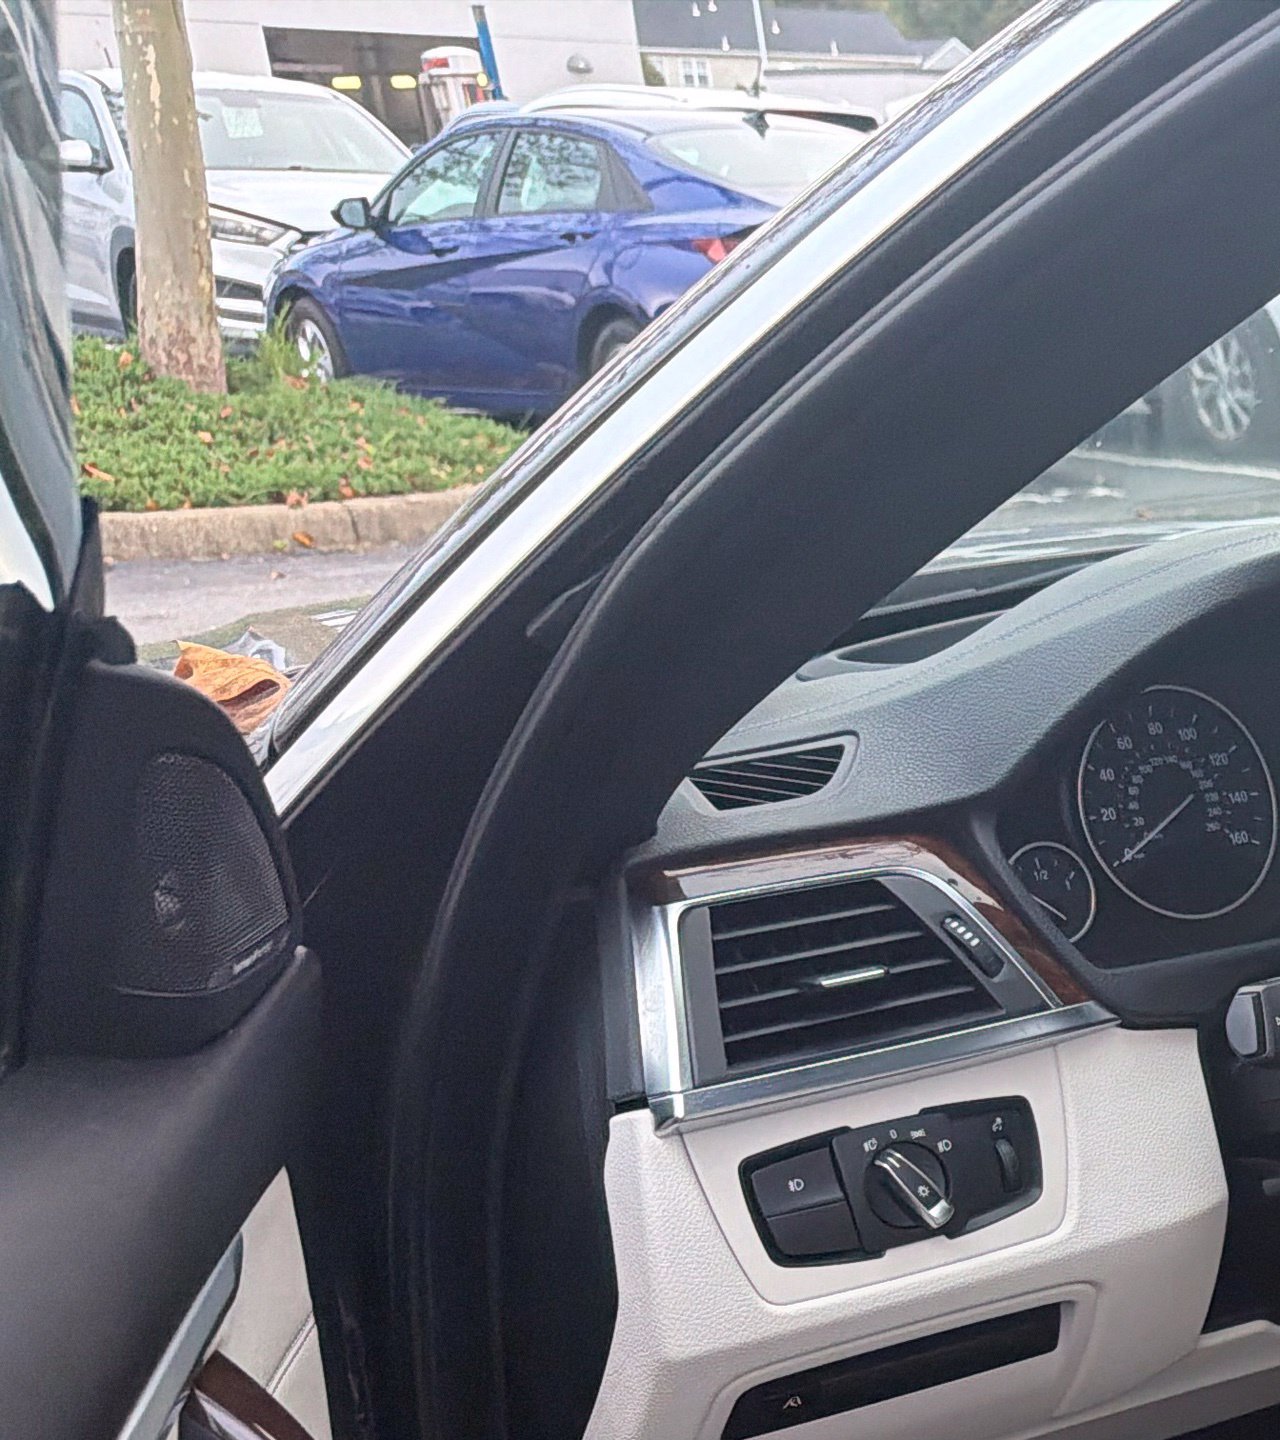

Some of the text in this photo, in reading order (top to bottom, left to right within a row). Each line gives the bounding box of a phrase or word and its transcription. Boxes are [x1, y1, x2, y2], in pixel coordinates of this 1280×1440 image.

[1148, 721, 1163, 736] 80
[1178, 728, 1198, 743] 100
[1117, 736, 1132, 750] 60
[1209, 752, 1228, 767] 120
[1100, 768, 1115, 782] 40
[1228, 791, 1248, 804] 140
[1101, 807, 1117, 822] 20
[1133, 816, 1145, 827] 20
[1229, 831, 1249, 845] 160
